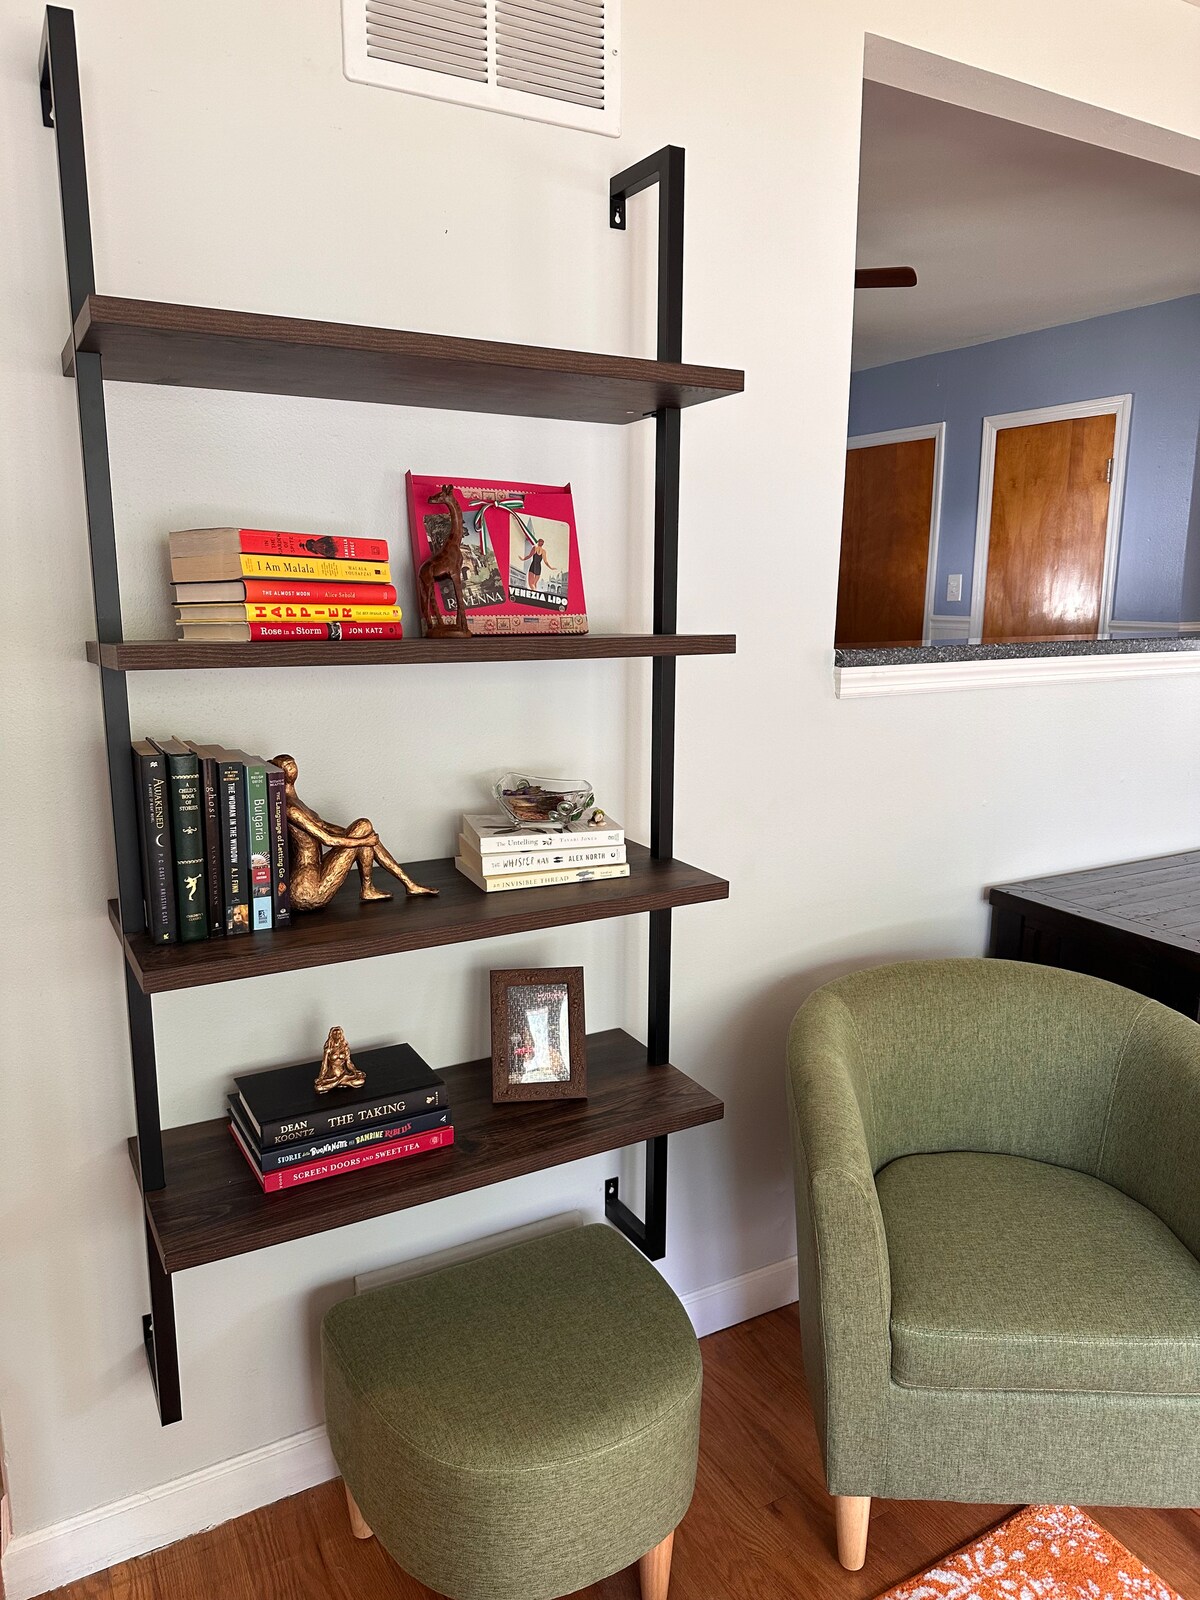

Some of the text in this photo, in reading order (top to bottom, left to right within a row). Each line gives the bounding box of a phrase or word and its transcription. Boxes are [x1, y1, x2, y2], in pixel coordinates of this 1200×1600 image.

[257, 561, 261, 571] I
[265, 562, 281, 572] Am
[283, 563, 315, 574] Malala
[338, 591, 356, 599] Sebold
[509, 586, 568, 606] VENEZIA LIDO
[255, 606, 352, 618] HAPPIER
[260, 627, 282, 636] Rose
[296, 626, 322, 635] Storm
[206, 786, 217, 819] ghost
[228, 782, 238, 863] THE WOMAN IN THE WINDOW
[252, 798, 266, 841] Bulgaria
[274, 801, 282, 834] Language
[507, 838, 539, 847] Untelling
[276, 843, 285, 867] Letting
[503, 856, 535, 868] WHISPER
[568, 854, 583, 862] ALEX
[585, 852, 606, 861] NORTH
[278, 867, 286, 878] Go
[502, 879, 538, 888] INVISIBLE
[540, 875, 569, 884] THREAD
[327, 1101, 407, 1128] THE TAKING
[280, 1120, 308, 1134] DEAN
[274, 1128, 315, 1144] KOONTZ
[277, 1152, 302, 1164] STORIE
[355, 1130, 384, 1144] BAMBINE
[293, 1142, 420, 1181] SCREEN DOORS AND SWEET TEA
